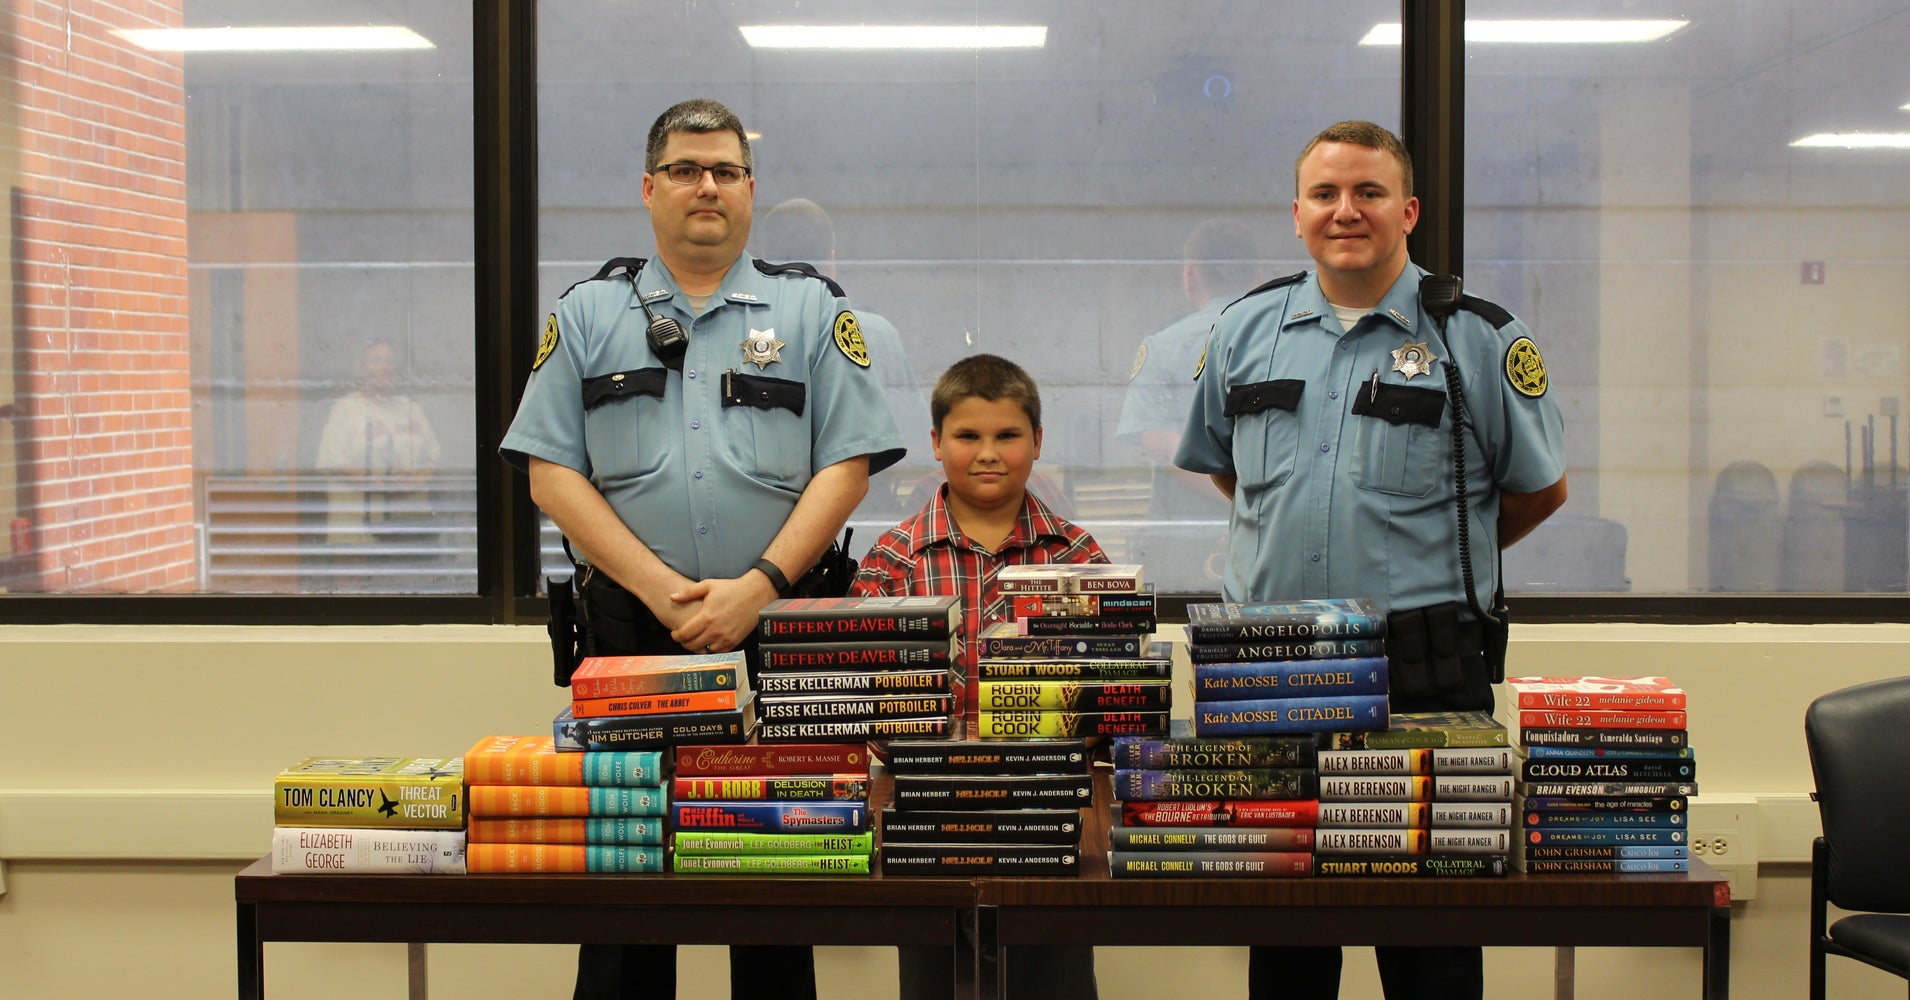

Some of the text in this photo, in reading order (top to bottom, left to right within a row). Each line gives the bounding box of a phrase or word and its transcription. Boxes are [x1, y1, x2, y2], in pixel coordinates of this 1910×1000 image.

[773, 620, 834, 635] JEFFERY
[838, 618, 896, 632] DEAVER
[1239, 624, 1360, 637] ANGELOPOLIS
[990, 640, 1013, 655] Clara
[1049, 640, 1073, 655] Tiffany
[1236, 644, 1357, 658] ANGELOPOLIS
[773, 652, 835, 666] JEFFERY
[838, 650, 897, 663] DEAVER
[986, 665, 1031, 676] STUART
[1035, 664, 1081, 675] WOODS
[1100, 669, 1138, 677] DAMAGE
[761, 679, 796, 691] JESSE
[800, 677, 869, 691] KELLERMAN
[875, 675, 932, 688] POTBOILER
[1204, 673, 1354, 689] Kate MOSSE CITADEL
[992, 684, 1141, 695] ROBIN DEATH
[609, 699, 690, 711] CHRIS CULVER THE ABBEY
[992, 696, 1147, 707] COOK BENEFIT
[1543, 694, 1664, 706] Wife 22 melanie gideon
[765, 700, 936, 717] JESSE KELLERMAN POTBOILER
[1204, 707, 1354, 724] Kate MOSSE CITADEL
[992, 723, 1147, 735] COOK BENEFIT
[610, 731, 663, 741] BUTCHER
[1526, 731, 1662, 744] Conquistadora Esmeralda Santiago
[696, 748, 756, 769] Catherine
[778, 755, 806, 763] ROBERT
[1170, 753, 1251, 766] BROKEN
[1324, 757, 1348, 771] ALEX
[1351, 756, 1404, 770] BERENSON
[1437, 757, 1448, 766] THE
[1450, 757, 1468, 766] NIGHT
[1471, 757, 1495, 766] RANGER
[1529, 765, 1628, 776] CLOUD ATLAS
[400, 787, 442, 800] THREAT
[688, 780, 761, 799] J. D. ROBB
[790, 790, 824, 798] DEATH
[1171, 783, 1253, 796] BROKEN
[1537, 785, 1666, 795] BRIAN EVENSON IMMOBILITY
[284, 789, 374, 807] TOM CLANCY
[403, 804, 446, 818] VECTOR
[1145, 813, 1155, 821] THE
[1155, 811, 1191, 822] BOURNE
[679, 808, 735, 827] Griffin
[783, 815, 844, 827] Spymasters
[300, 832, 352, 849] ELIZABETH
[682, 838, 744, 849] Janet Evanovich
[751, 840, 811, 848] LEE GOLDBERG
[823, 839, 853, 850] HEIST
[1130, 835, 1196, 845] MICHAEL CONNELLY
[1204, 834, 1267, 844] THE GODS OF GUILT
[374, 842, 438, 851] BELIEVING
[1535, 848, 1612, 857] JOHN GRISHAM
[305, 852, 345, 869] GEORGE
[407, 854, 427, 864] LIE
[680, 859, 741, 869] Janet Evanovich
[1127, 862, 1193, 871] MICHAEL CONNELLY
[1535, 862, 1612, 870] JOHN GRISHAM
